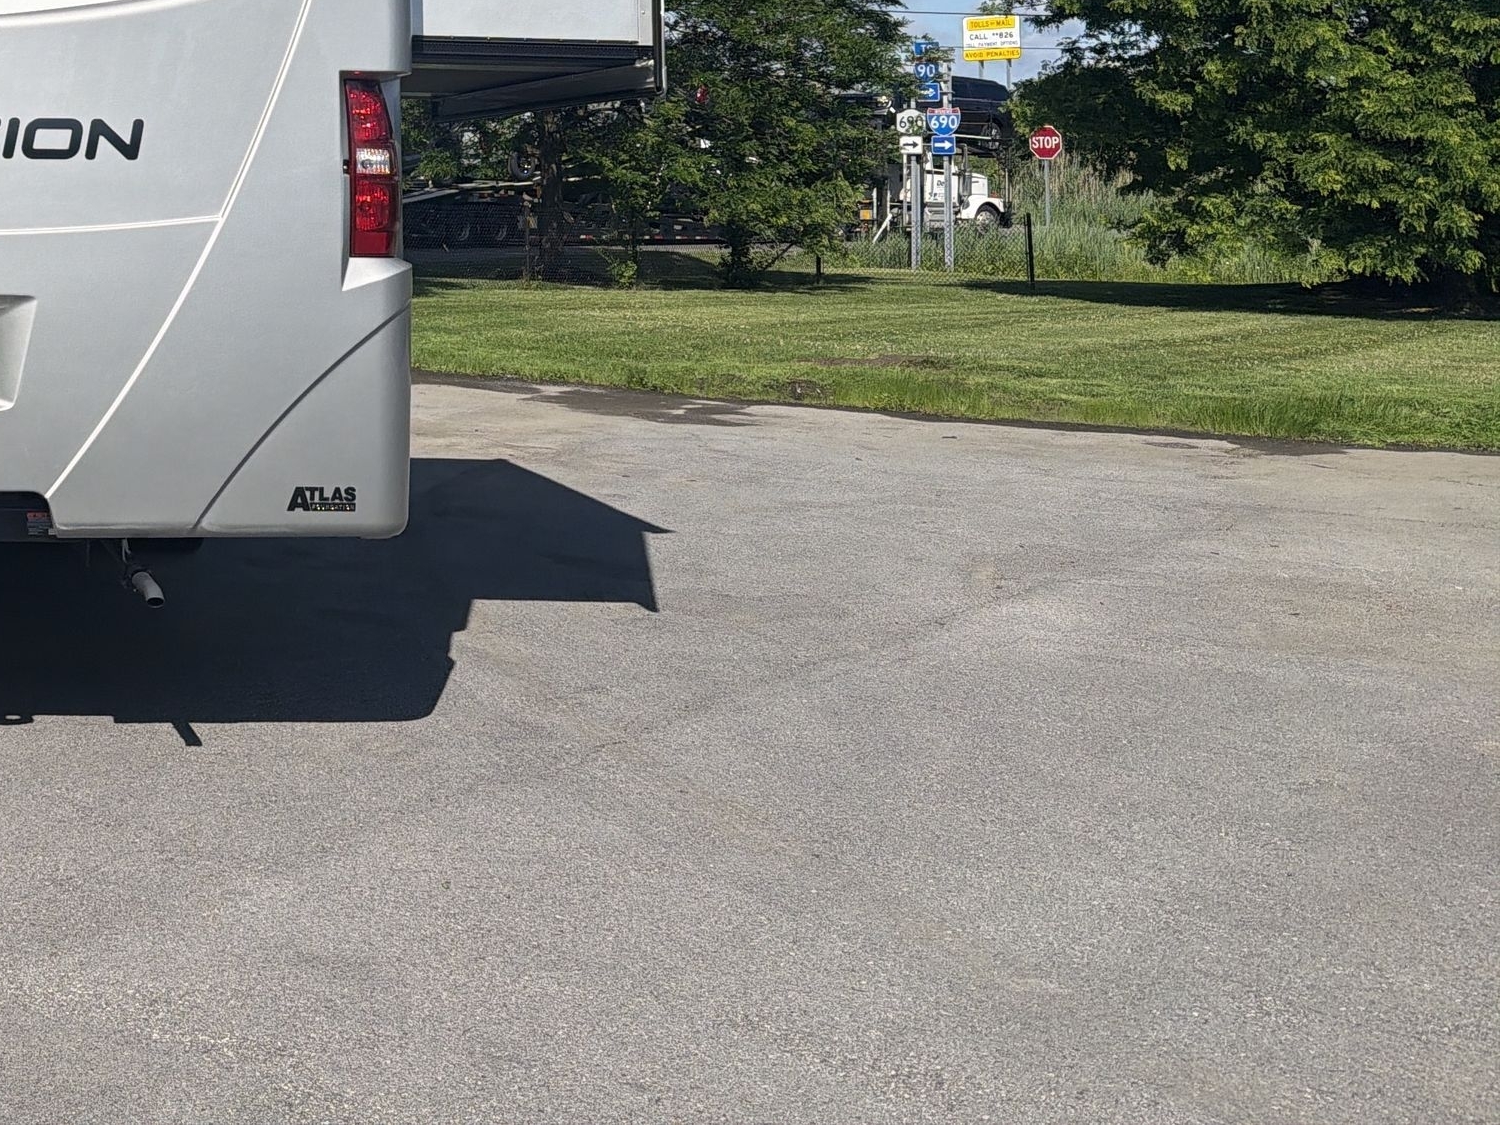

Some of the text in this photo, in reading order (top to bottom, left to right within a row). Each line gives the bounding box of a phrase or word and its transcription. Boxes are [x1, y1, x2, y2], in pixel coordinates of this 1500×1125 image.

[986, 49, 1020, 57] PENALTIES
[917, 64, 936, 77] 90
[930, 115, 958, 129] 690
[1032, 136, 1059, 148] STOP
[287, 486, 356, 511] ATLAS
